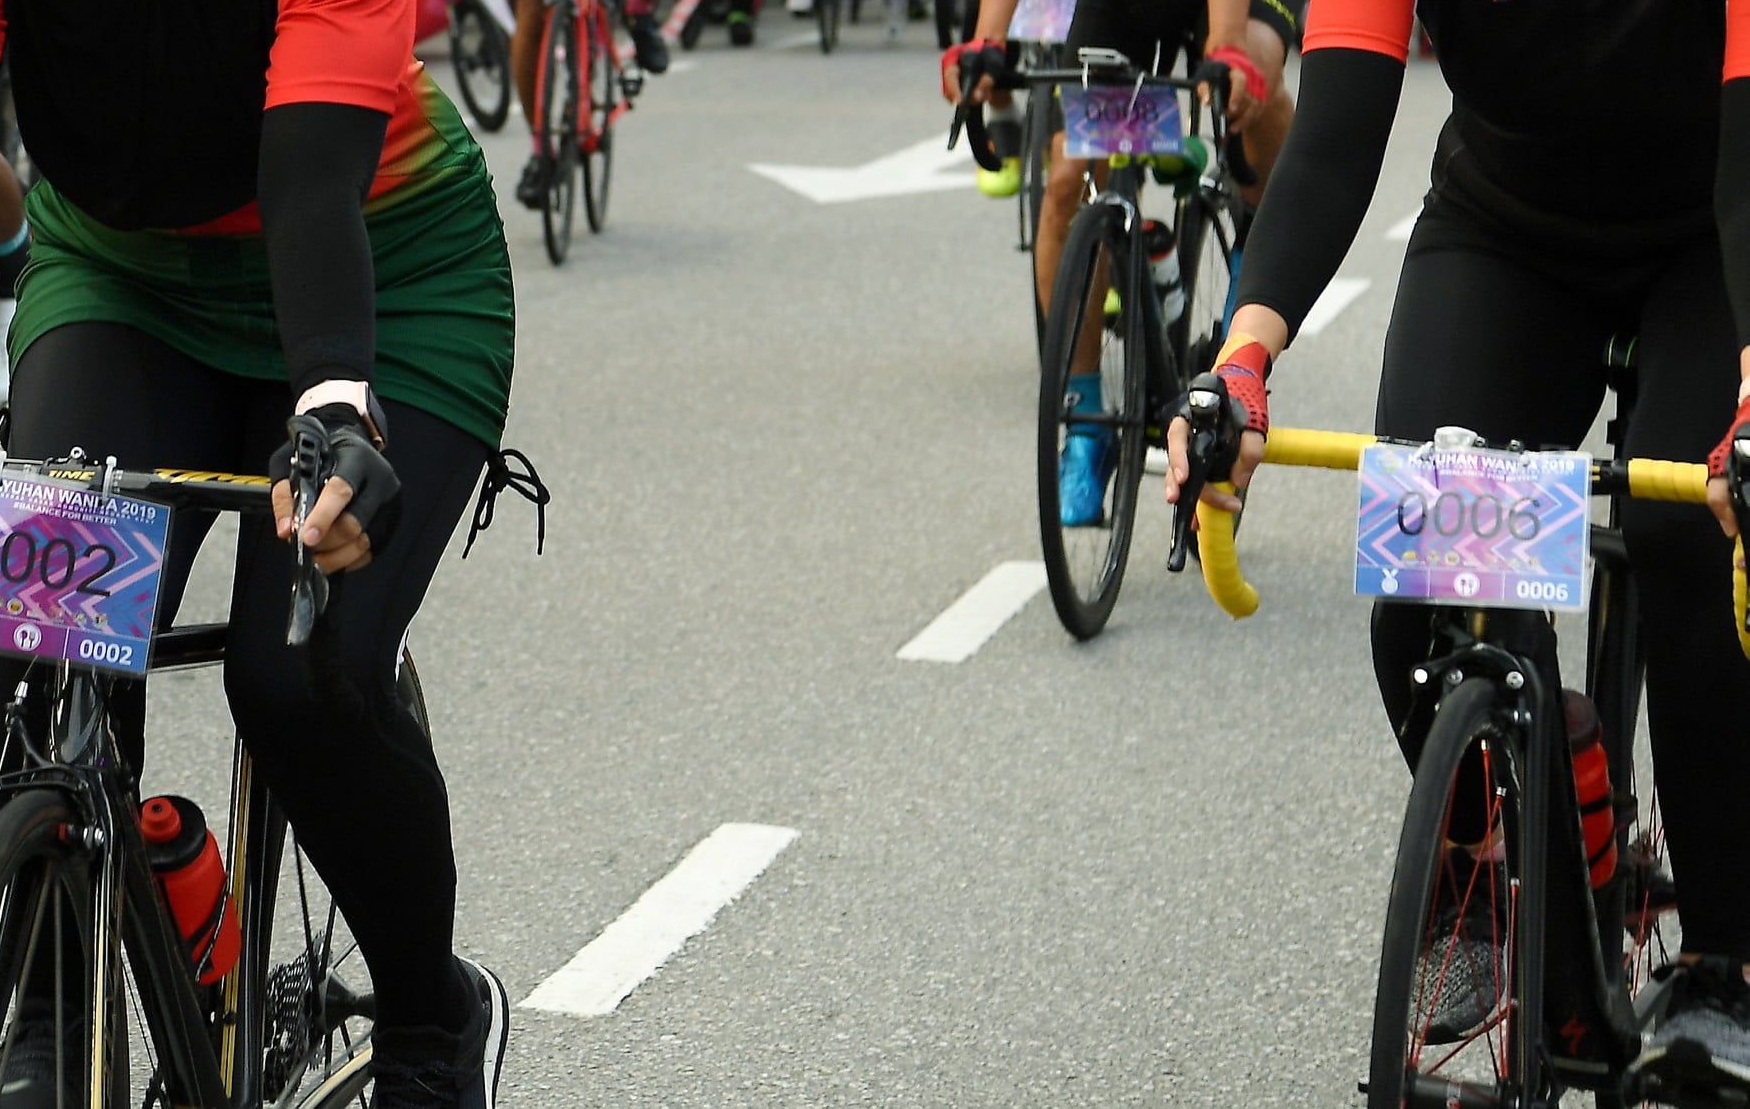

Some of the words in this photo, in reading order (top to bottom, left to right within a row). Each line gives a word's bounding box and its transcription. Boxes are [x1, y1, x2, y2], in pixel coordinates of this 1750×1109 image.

[48, 469, 96, 481] TIME
[13, 501, 62, 519] #BALANCE
[62, 510, 81, 521] FOR
[82, 513, 117, 526] BETTER
[57, 489, 119, 513] WANIA
[121, 501, 156, 520] 2019
[1398, 490, 1540, 541] 0006
[1516, 580, 1569, 602] 0006
[78, 639, 133, 666] 0002
